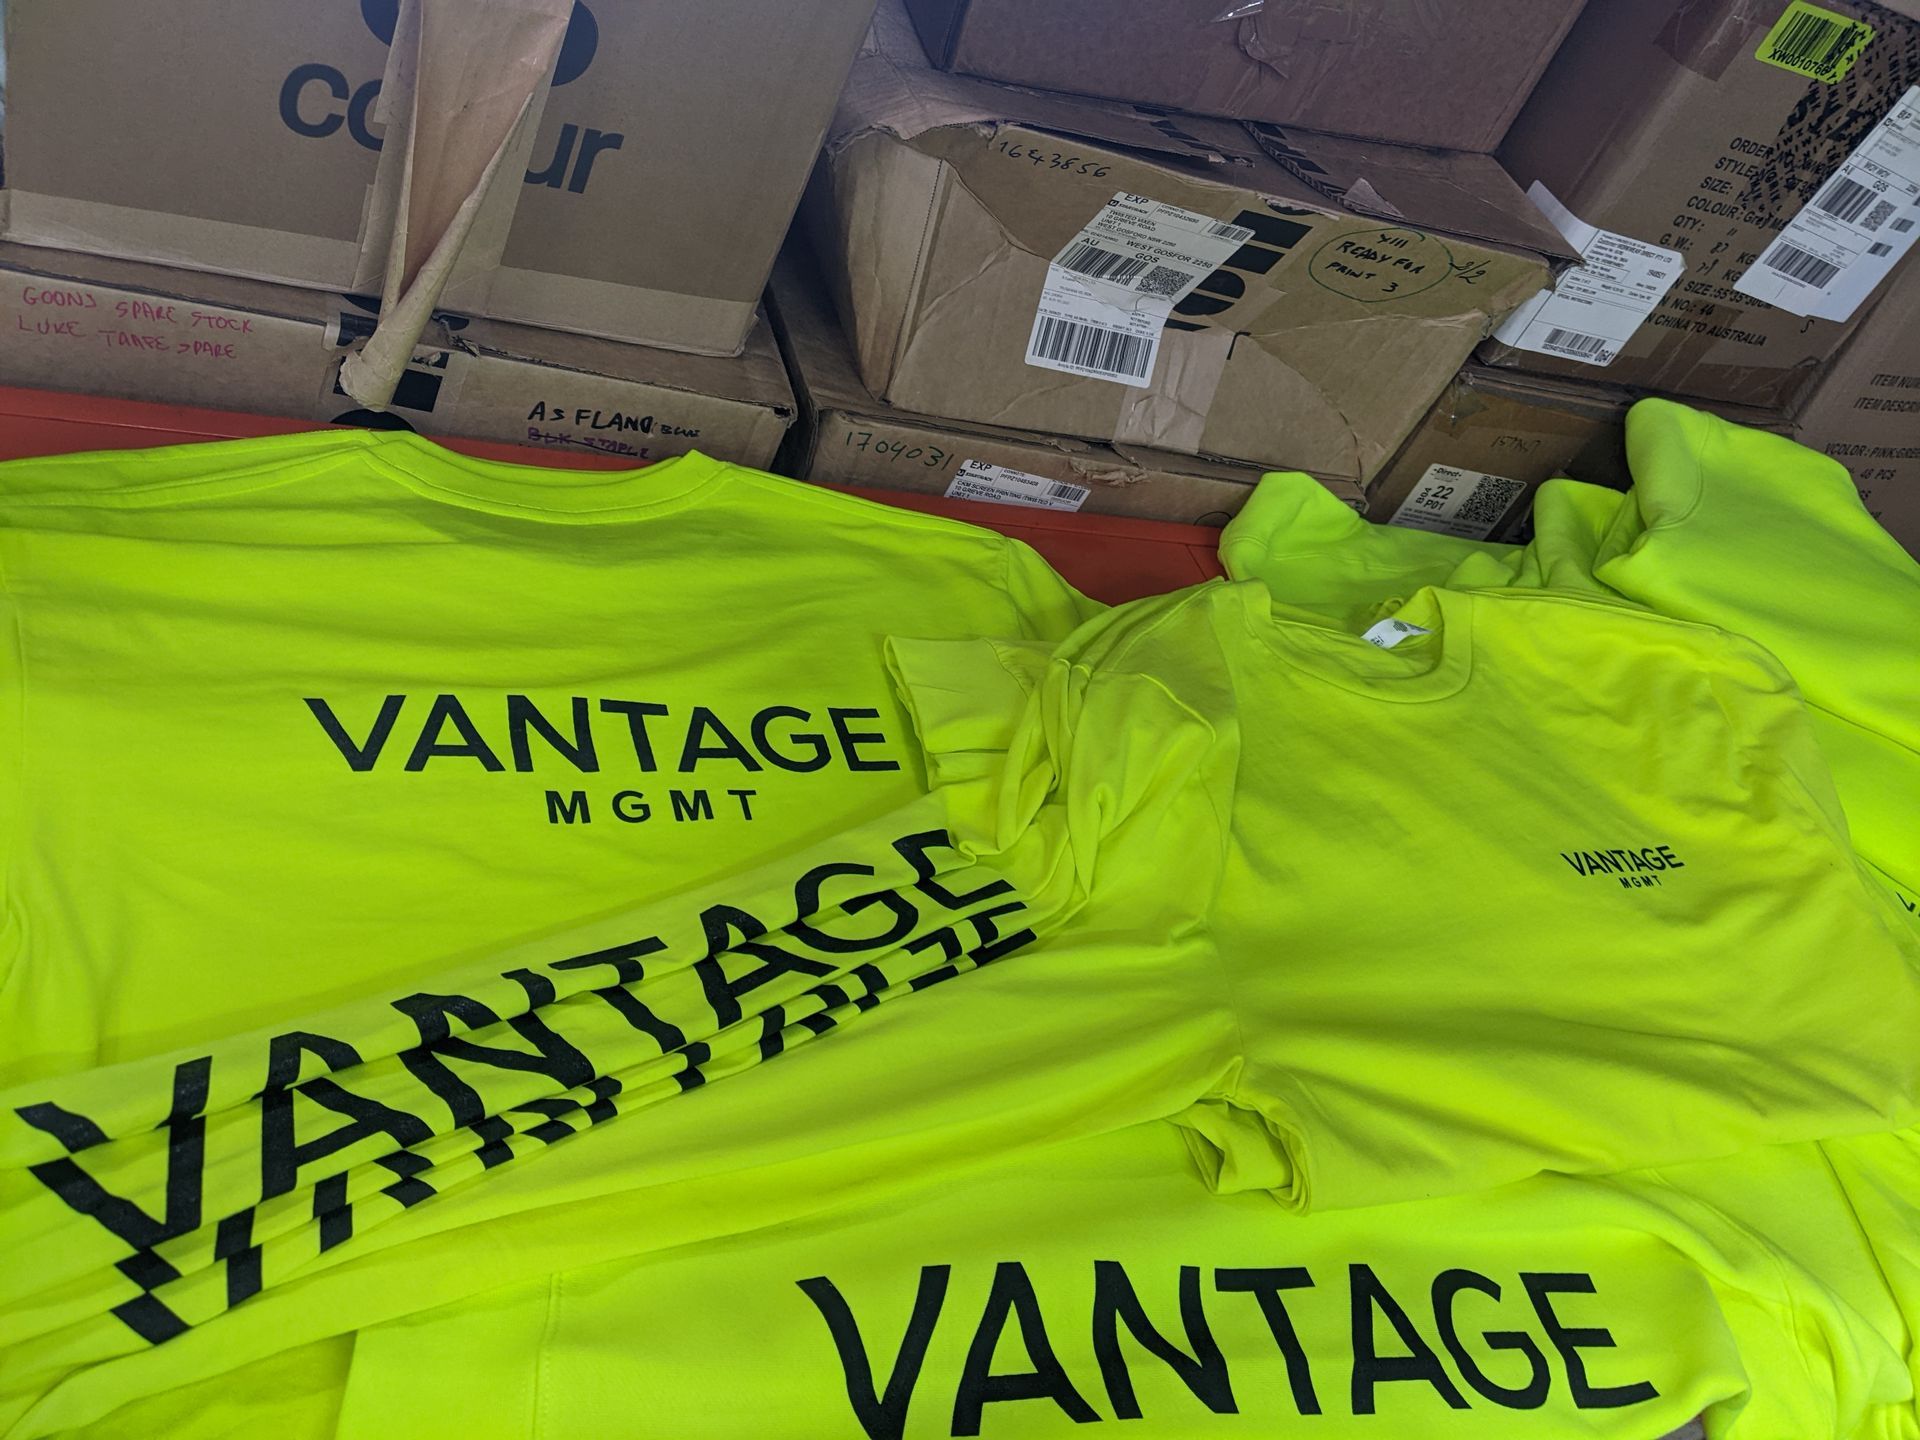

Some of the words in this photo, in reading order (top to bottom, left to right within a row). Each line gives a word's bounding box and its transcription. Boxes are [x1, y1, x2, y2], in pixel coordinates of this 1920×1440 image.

[1730, 137, 1775, 160] ORDER
[1715, 157, 1759, 178] STYLE
[1125, 194, 1149, 205] EXP
[1101, 218, 1116, 226] UNIT
[1109, 210, 1138, 222] TWISTED
[1137, 217, 1156, 226] VIXEN
[1113, 215, 1137, 227] GRIEVE
[1137, 223, 1156, 232] ROAD
[1097, 222, 1116, 230] WEST
[1116, 228, 1147, 239] GOSFORD
[1147, 235, 1162, 243] NSW
[1081, 237, 1100, 247] AU
[1134, 252, 1160, 264] GOS
[1126, 240, 1154, 251] WEST
[1153, 248, 1191, 263] GOSFOR
[1192, 258, 1213, 269] 2250
[1336, 241, 1392, 263] READY
[1326, 262, 1376, 280] PRINT
[116, 302, 176, 323] SPARE
[192, 311, 253, 334] STOCK
[1655, 314, 1693, 331] CHINA
[1691, 321, 1708, 333] TO
[1707, 325, 1768, 346] AUSTRALIA
[177, 343, 238, 360] SPARE
[1853, 397, 1883, 411] ITEM
[846, 431, 954, 472] 1704031
[970, 461, 992, 471] EXP
[972, 482, 999, 493] SCREEN
[999, 488, 1023, 499] PRINTING
[984, 491, 1001, 500] ROAD
[1431, 485, 1454, 500] 22
[1424, 499, 1445, 511] P01
[302, 694, 901, 772] VANTAGE
[545, 789, 757, 825] MGMT
[1560, 845, 1685, 876] VANTAGE
[1619, 875, 1662, 889] MGMT
[15, 828, 1038, 1345] VANTAGE
[795, 1260, 1660, 1440] VANTAGE
